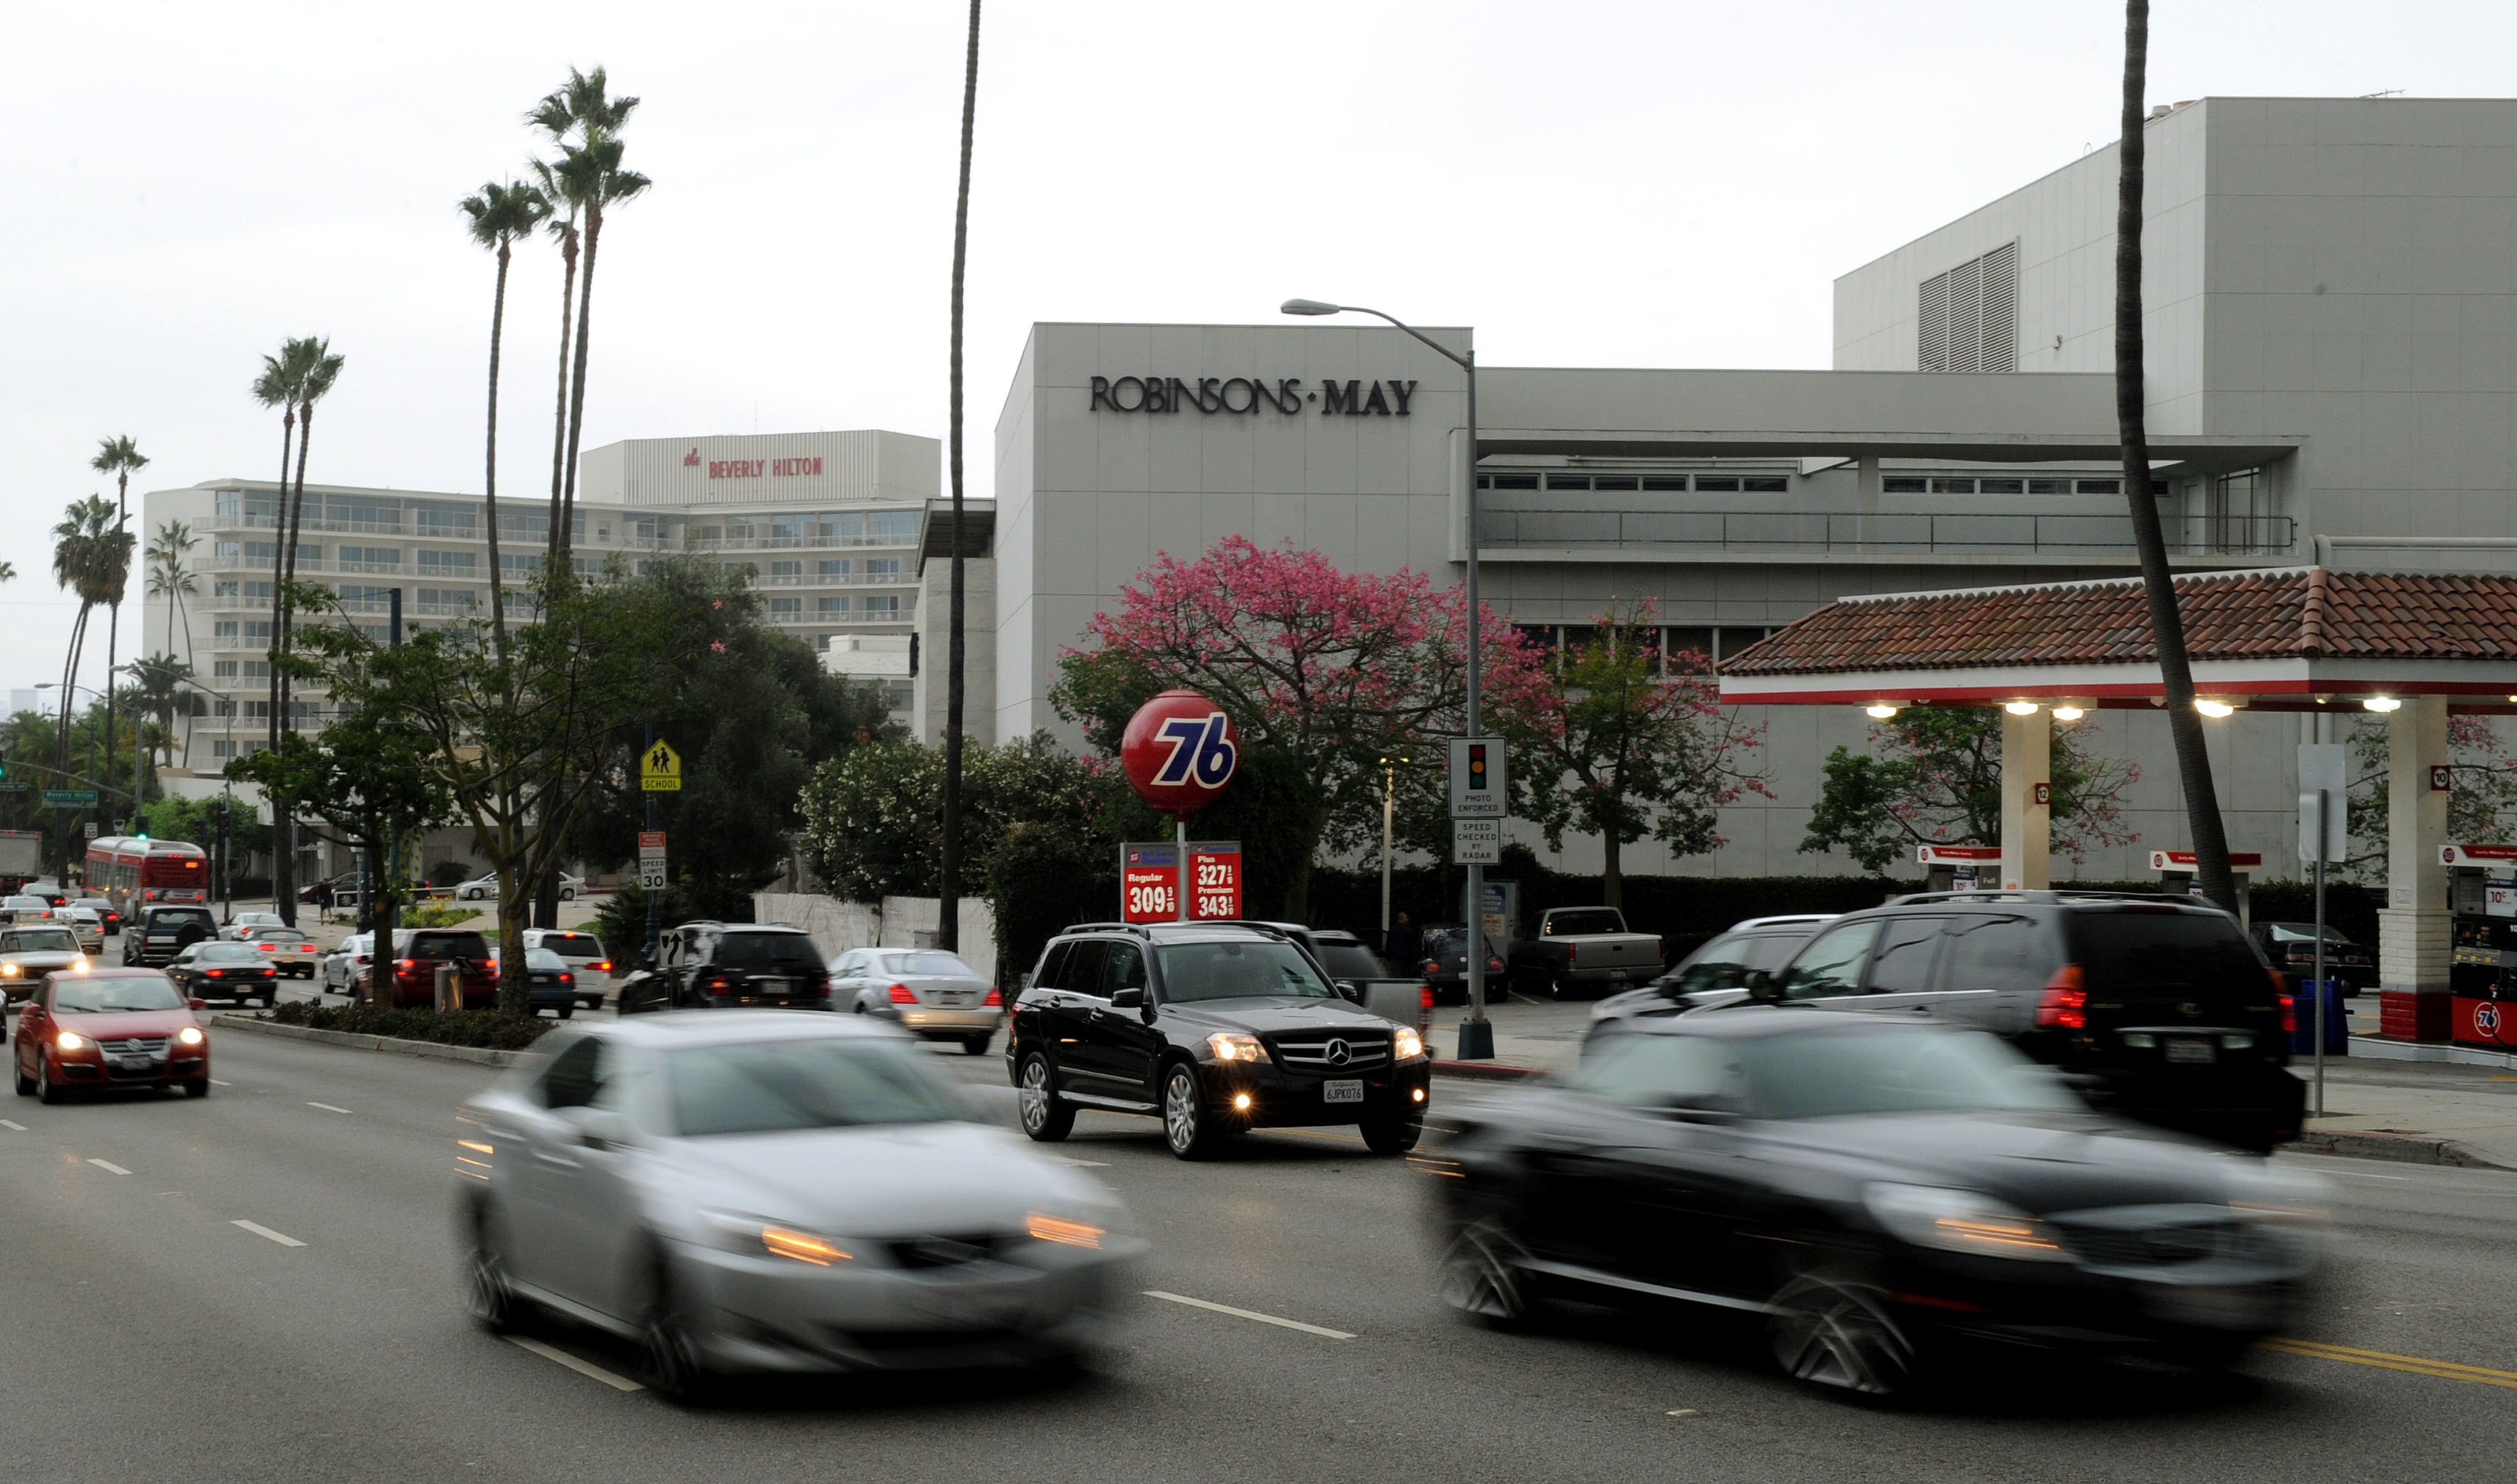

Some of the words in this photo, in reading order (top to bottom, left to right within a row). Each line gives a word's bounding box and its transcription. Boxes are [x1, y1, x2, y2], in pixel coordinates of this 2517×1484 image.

[709, 459, 764, 479] BEVERLY
[772, 457, 822, 476] HILTON
[1150, 712, 1236, 789] 76
[645, 779, 678, 789] SCHOOL
[2435, 772, 2446, 783] 10
[2038, 790, 2047, 798] 12
[643, 875, 664, 887] 30
[1128, 873, 1163, 883] Regular
[1198, 865, 1227, 885] 327
[1129, 886, 1165, 913] 309
[1198, 896, 1228, 916] 343
[2478, 1009, 2497, 1028] 76
[1327, 1088, 1362, 1100] 6JPK076
